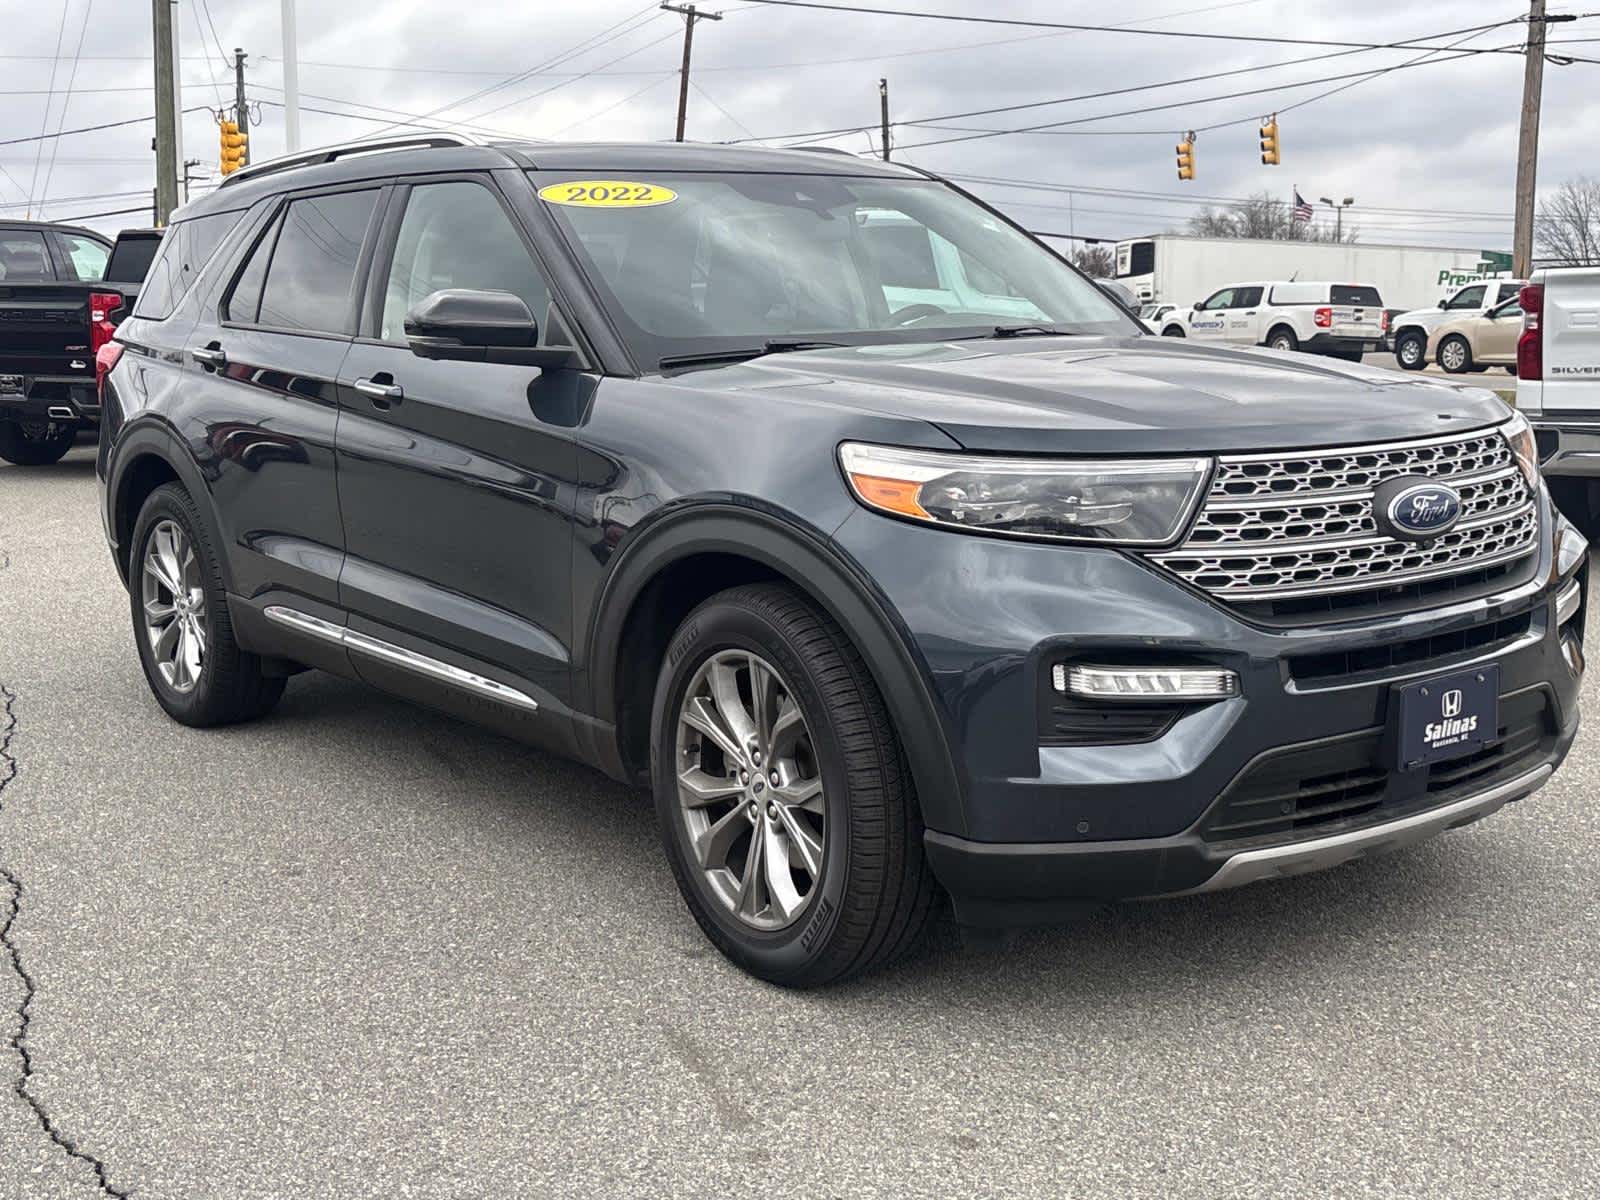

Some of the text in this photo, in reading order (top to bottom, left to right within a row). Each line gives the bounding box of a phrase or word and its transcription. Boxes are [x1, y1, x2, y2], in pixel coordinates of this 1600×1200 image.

[567, 186, 653, 201] 2022
[1411, 494, 1450, 524] Ford
[1423, 715, 1478, 743] Salinas
